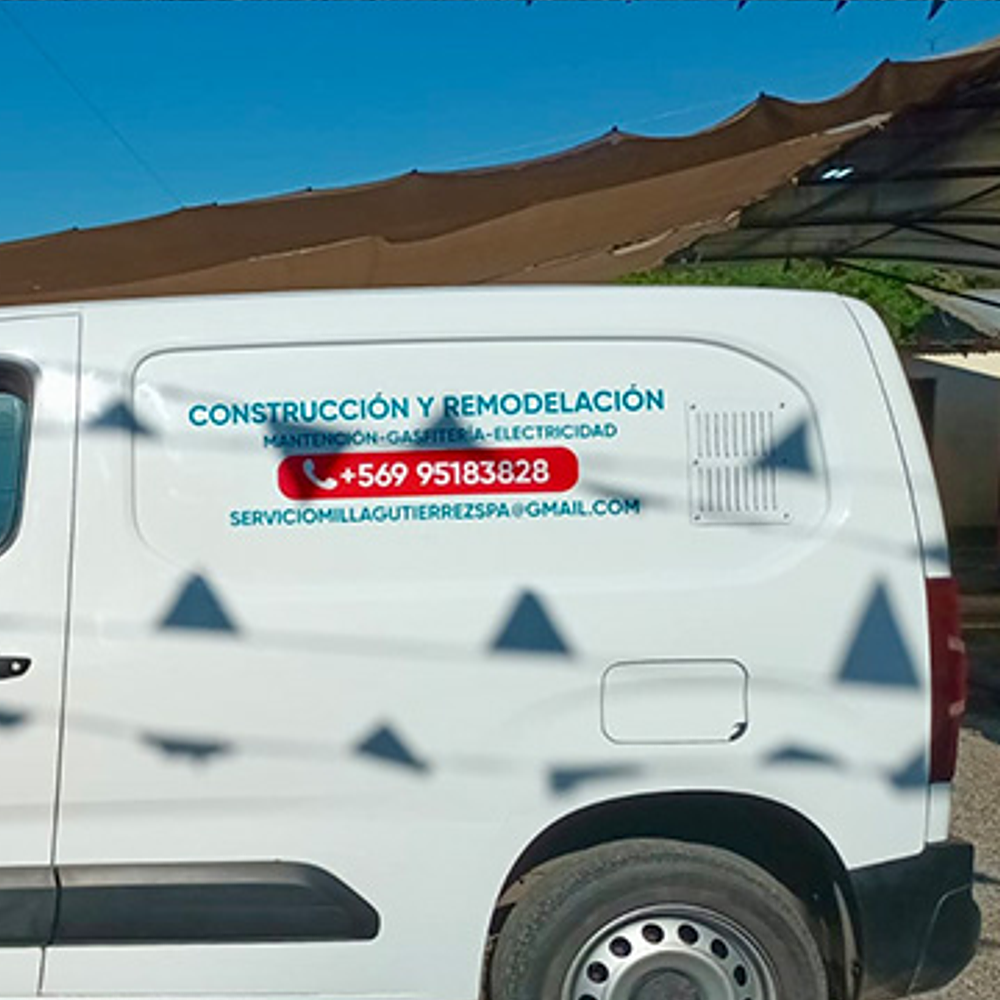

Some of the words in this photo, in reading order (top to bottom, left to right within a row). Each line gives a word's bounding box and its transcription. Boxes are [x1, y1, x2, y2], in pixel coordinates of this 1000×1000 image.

[188, 393, 410, 426] CONSTRUCCIÓN
[416, 396, 436, 420] Y
[442, 384, 666, 419] REMODELACIÓN
[339, 463, 409, 490] +569
[416, 458, 550, 488] 95183828
[229, 500, 641, 527] SERVICIOMILLAGUTIERREZSPA@GMAIL.COM
